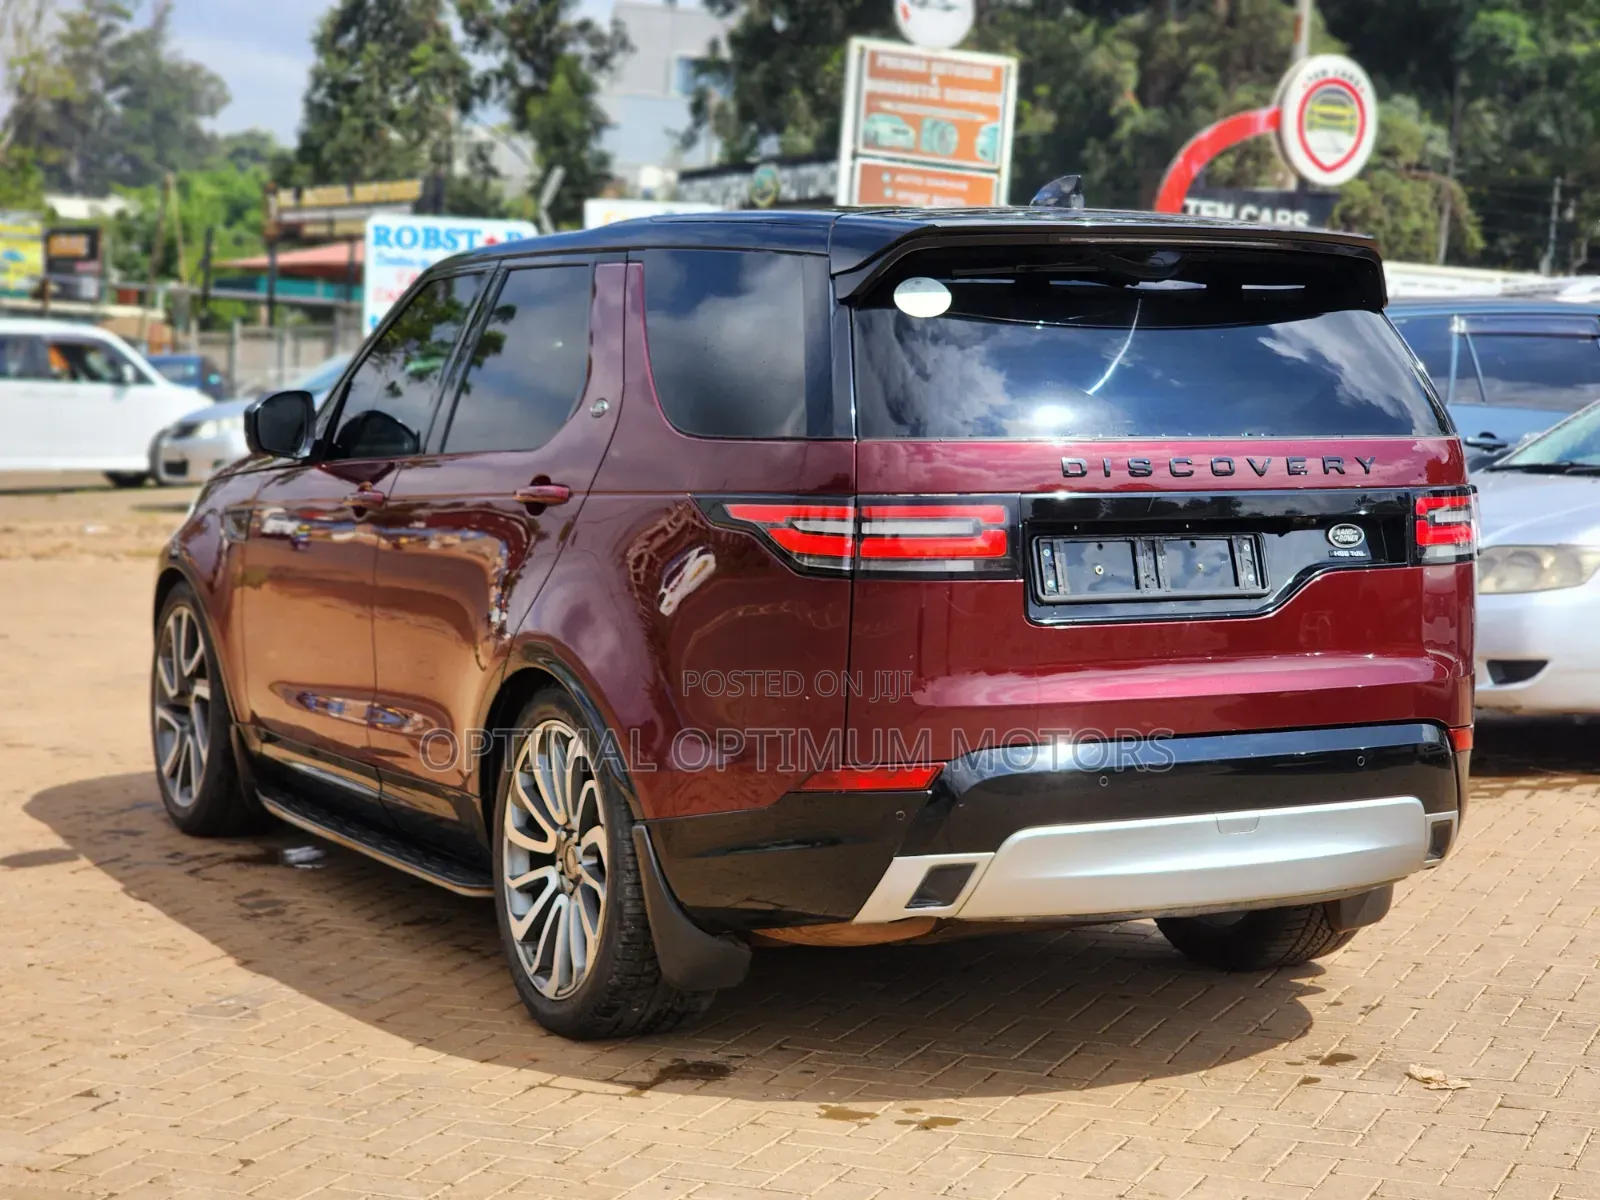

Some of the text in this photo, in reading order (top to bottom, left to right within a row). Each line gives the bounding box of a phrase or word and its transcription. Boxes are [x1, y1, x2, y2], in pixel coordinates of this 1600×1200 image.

[1183, 198, 1311, 227] TEN CARS
[1060, 454, 1377, 478] DISCOVERY
[1338, 534, 1359, 542] ROVER
